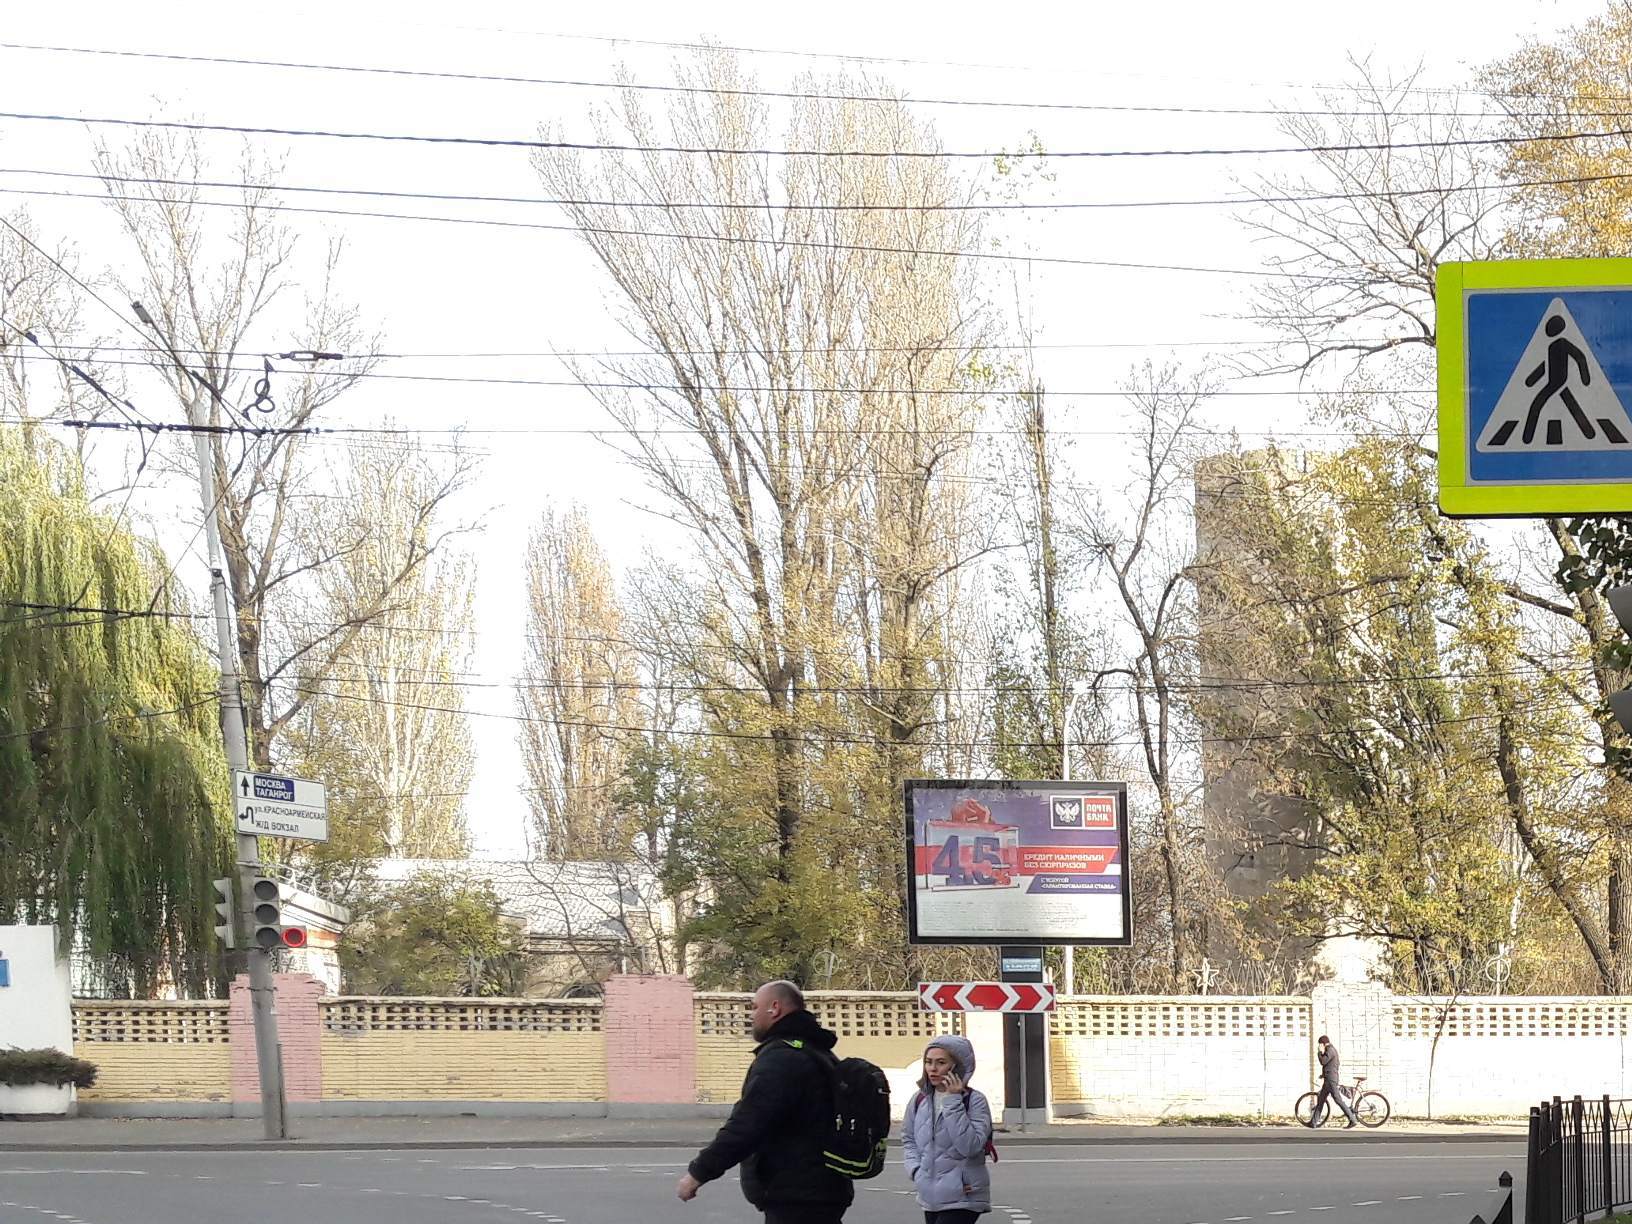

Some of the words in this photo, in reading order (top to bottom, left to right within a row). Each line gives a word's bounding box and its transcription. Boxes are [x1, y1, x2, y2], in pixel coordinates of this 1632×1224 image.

[255, 778, 286, 789] МОСКВА
[256, 787, 293, 800] ТАГАНРОГ
[1086, 804, 1112, 812] ПОЧТА
[1086, 813, 1109, 821] БАНК
[256, 820, 269, 831] Ж/Д
[272, 822, 299, 833] ВОКЗАЛ
